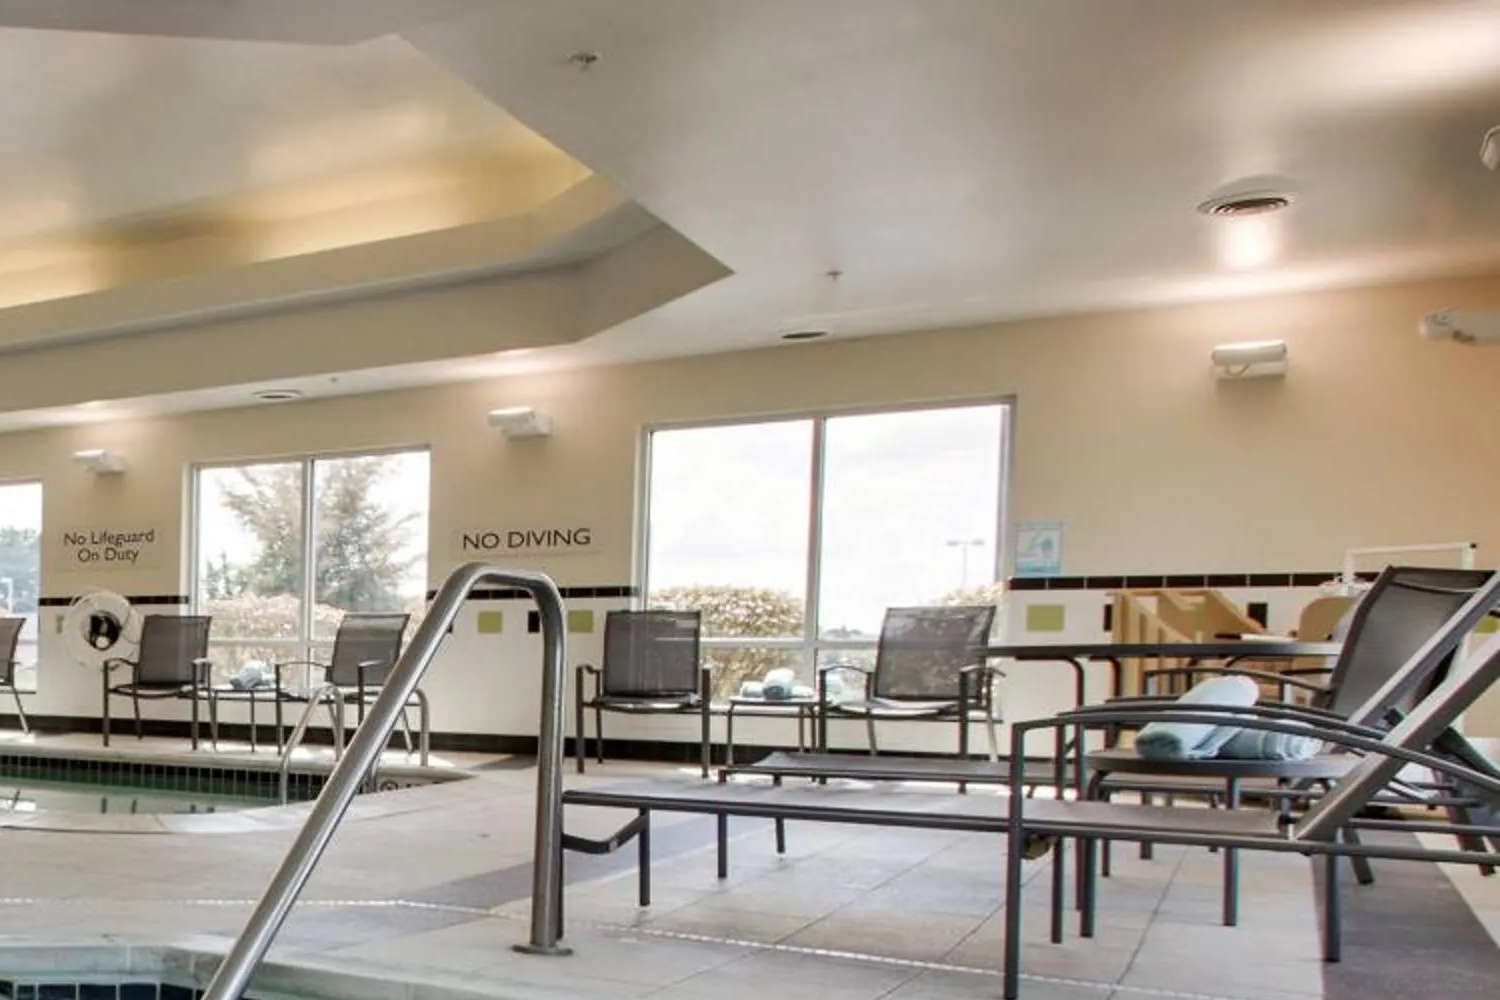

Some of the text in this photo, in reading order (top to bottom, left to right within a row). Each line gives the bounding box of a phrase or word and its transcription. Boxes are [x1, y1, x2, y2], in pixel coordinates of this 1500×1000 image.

[63, 528, 155, 549] No Lifeguard
[462, 527, 592, 549] NO DIVING
[77, 547, 140, 567] On Duty
